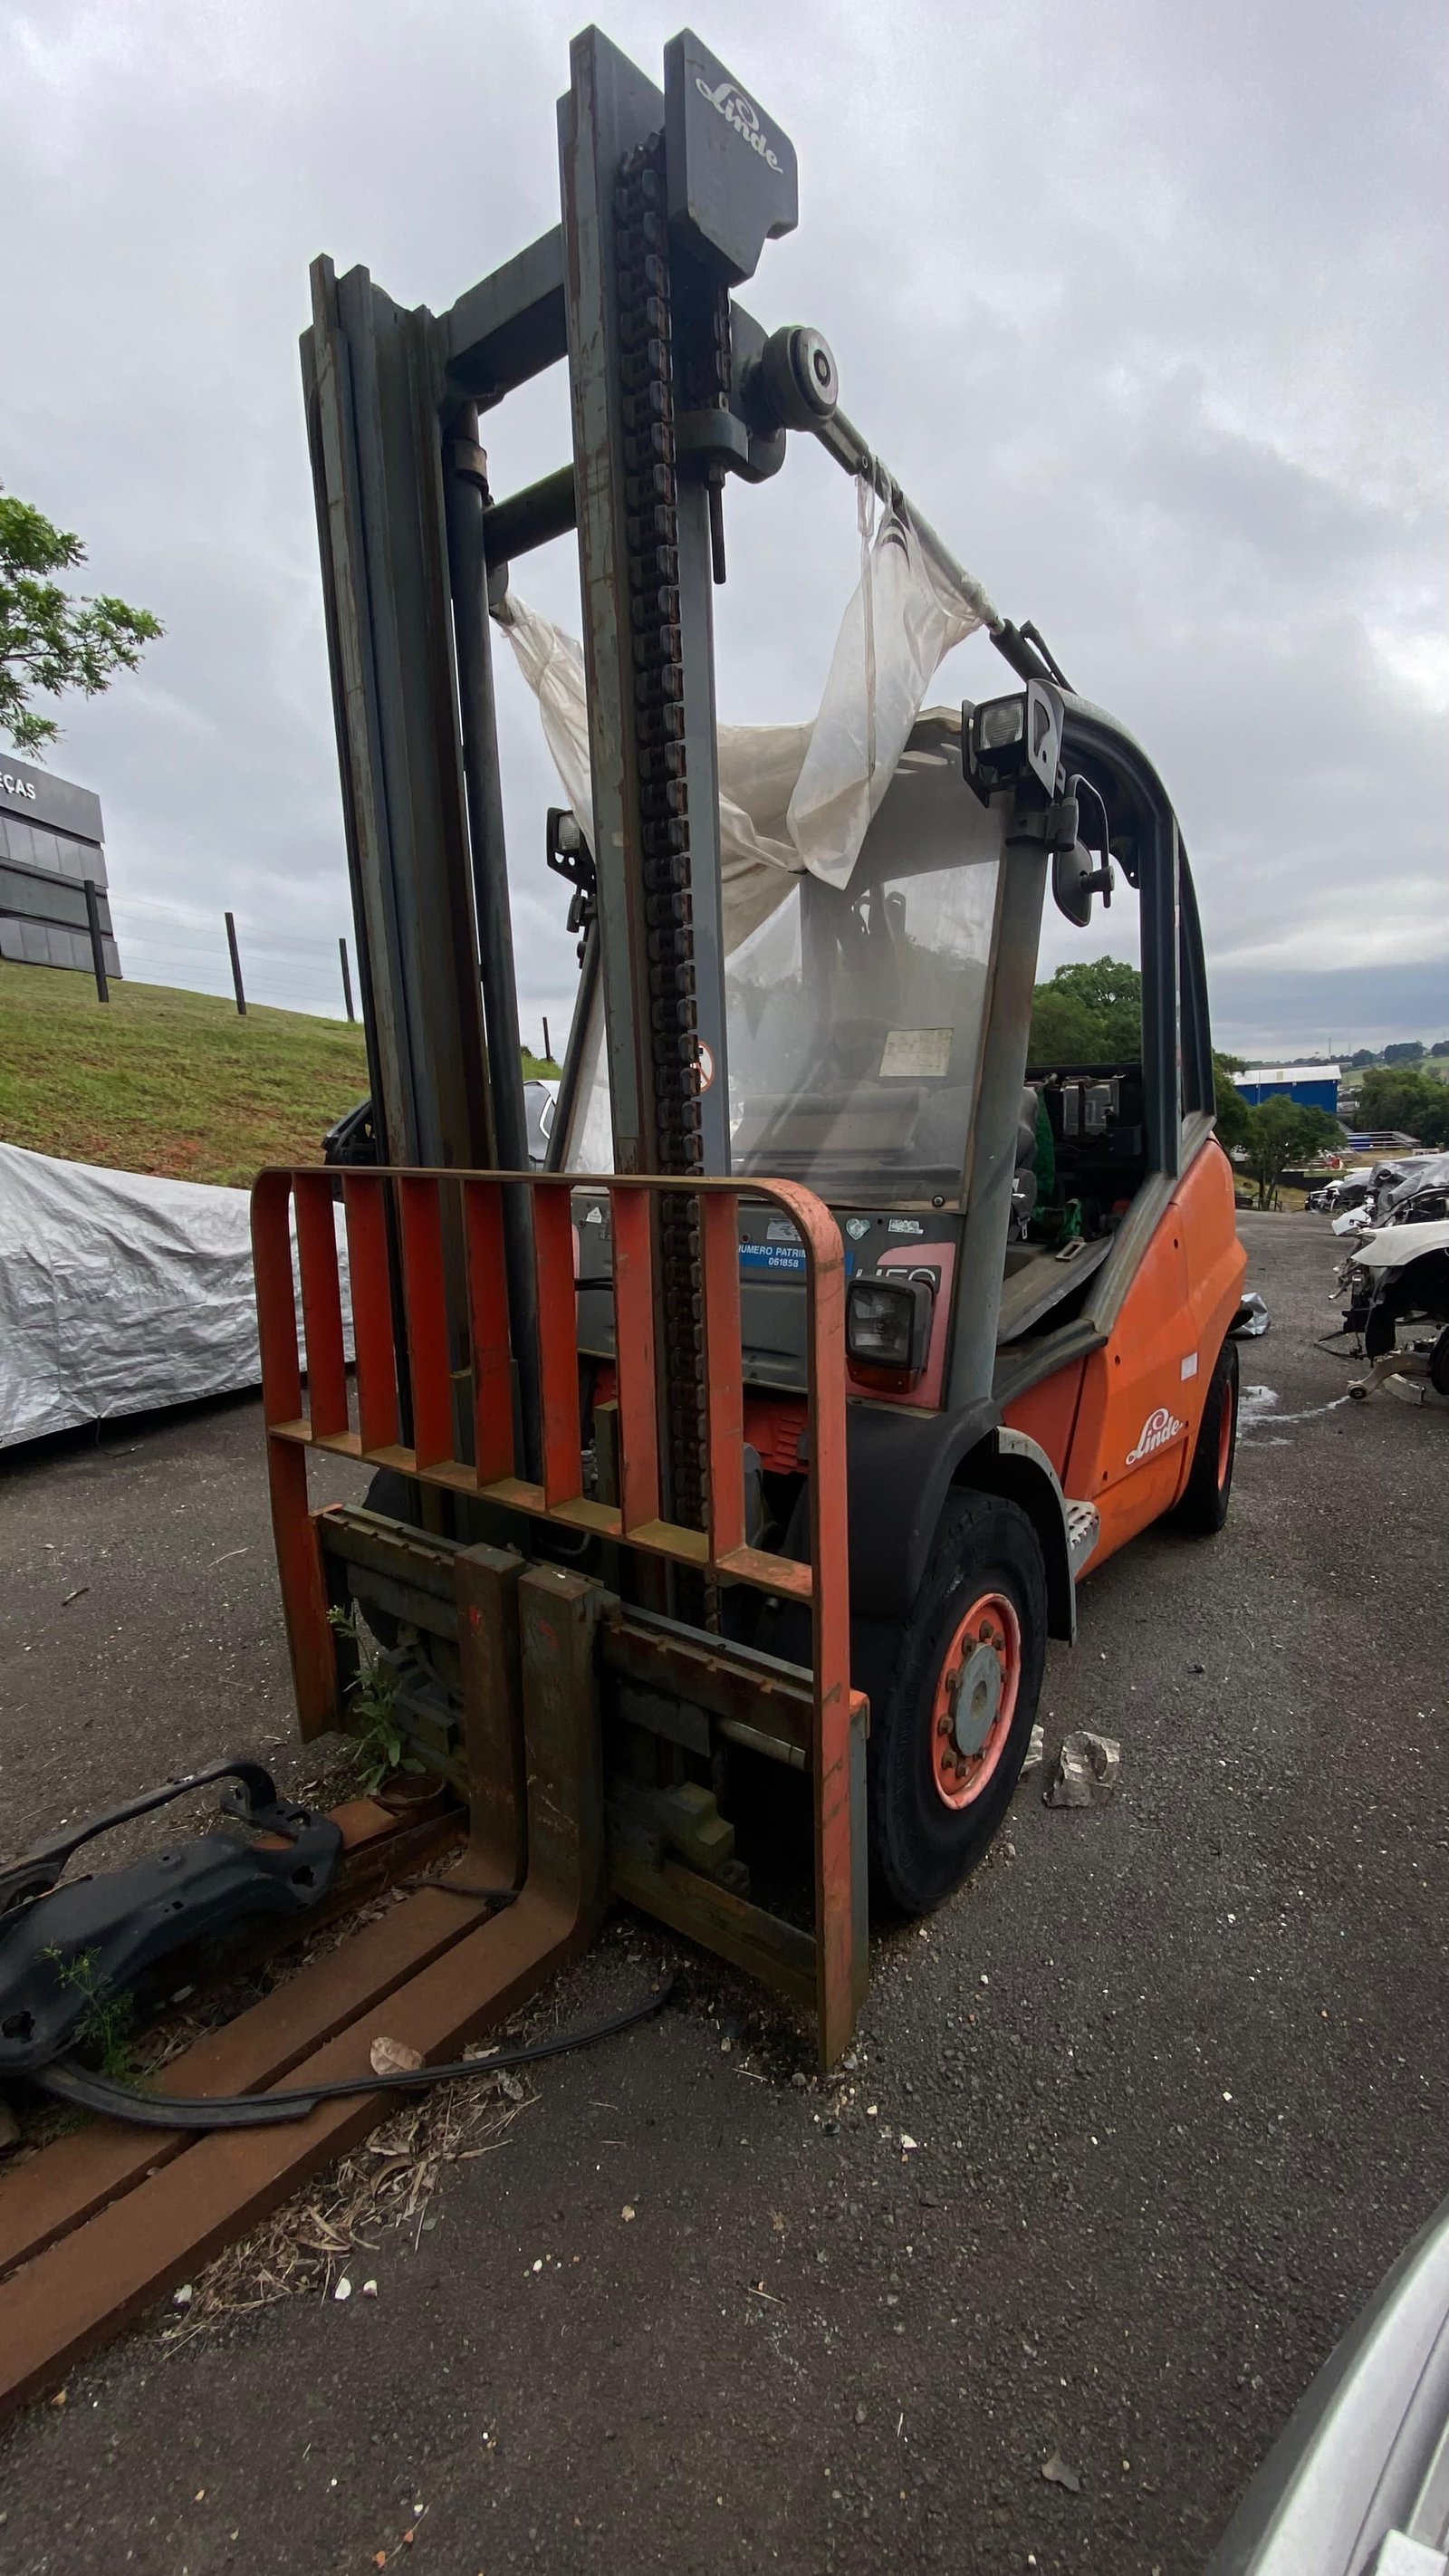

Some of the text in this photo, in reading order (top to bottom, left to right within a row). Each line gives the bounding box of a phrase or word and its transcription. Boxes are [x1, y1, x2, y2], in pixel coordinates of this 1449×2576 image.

[696, 78, 783, 173] Linde
[768, 1257, 799, 1268] 061858
[1126, 1408, 1184, 1465] Linde
